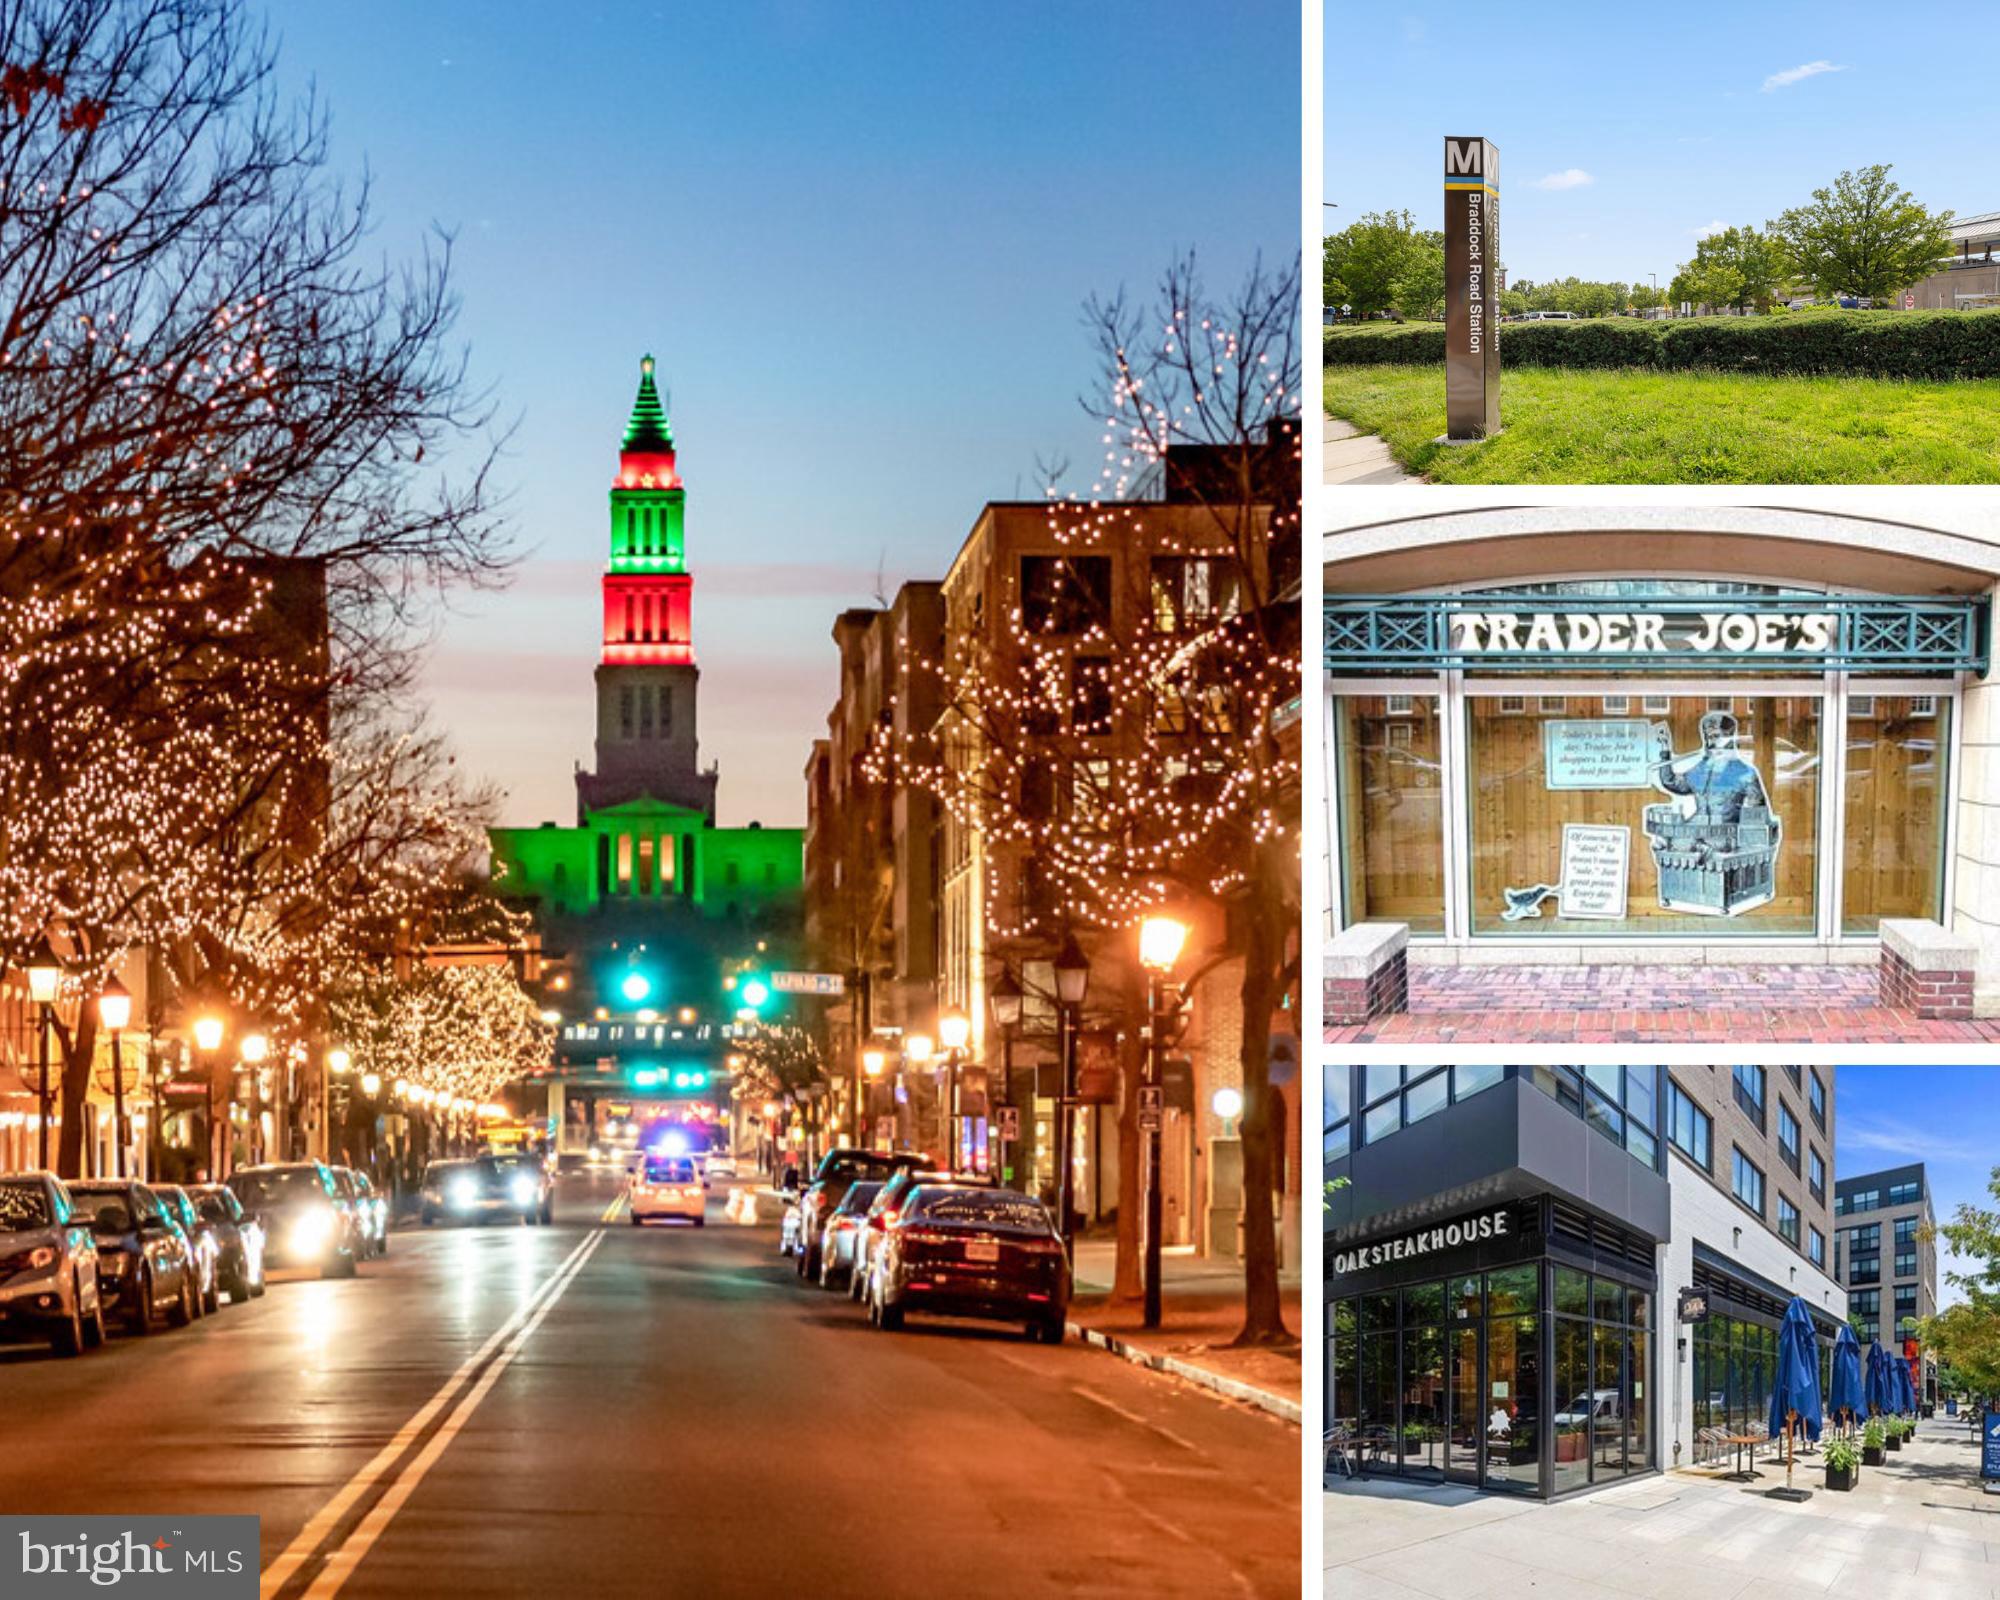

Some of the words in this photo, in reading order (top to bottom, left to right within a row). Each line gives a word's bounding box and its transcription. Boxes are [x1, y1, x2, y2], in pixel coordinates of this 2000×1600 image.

[1447, 141, 1481, 174] M
[1469, 193, 1481, 260] Braddock
[1470, 265, 1482, 301] Road
[1470, 304, 1482, 353] Station
[1450, 613, 1669, 651] TRADER
[1684, 613, 1829, 651] JOE'S
